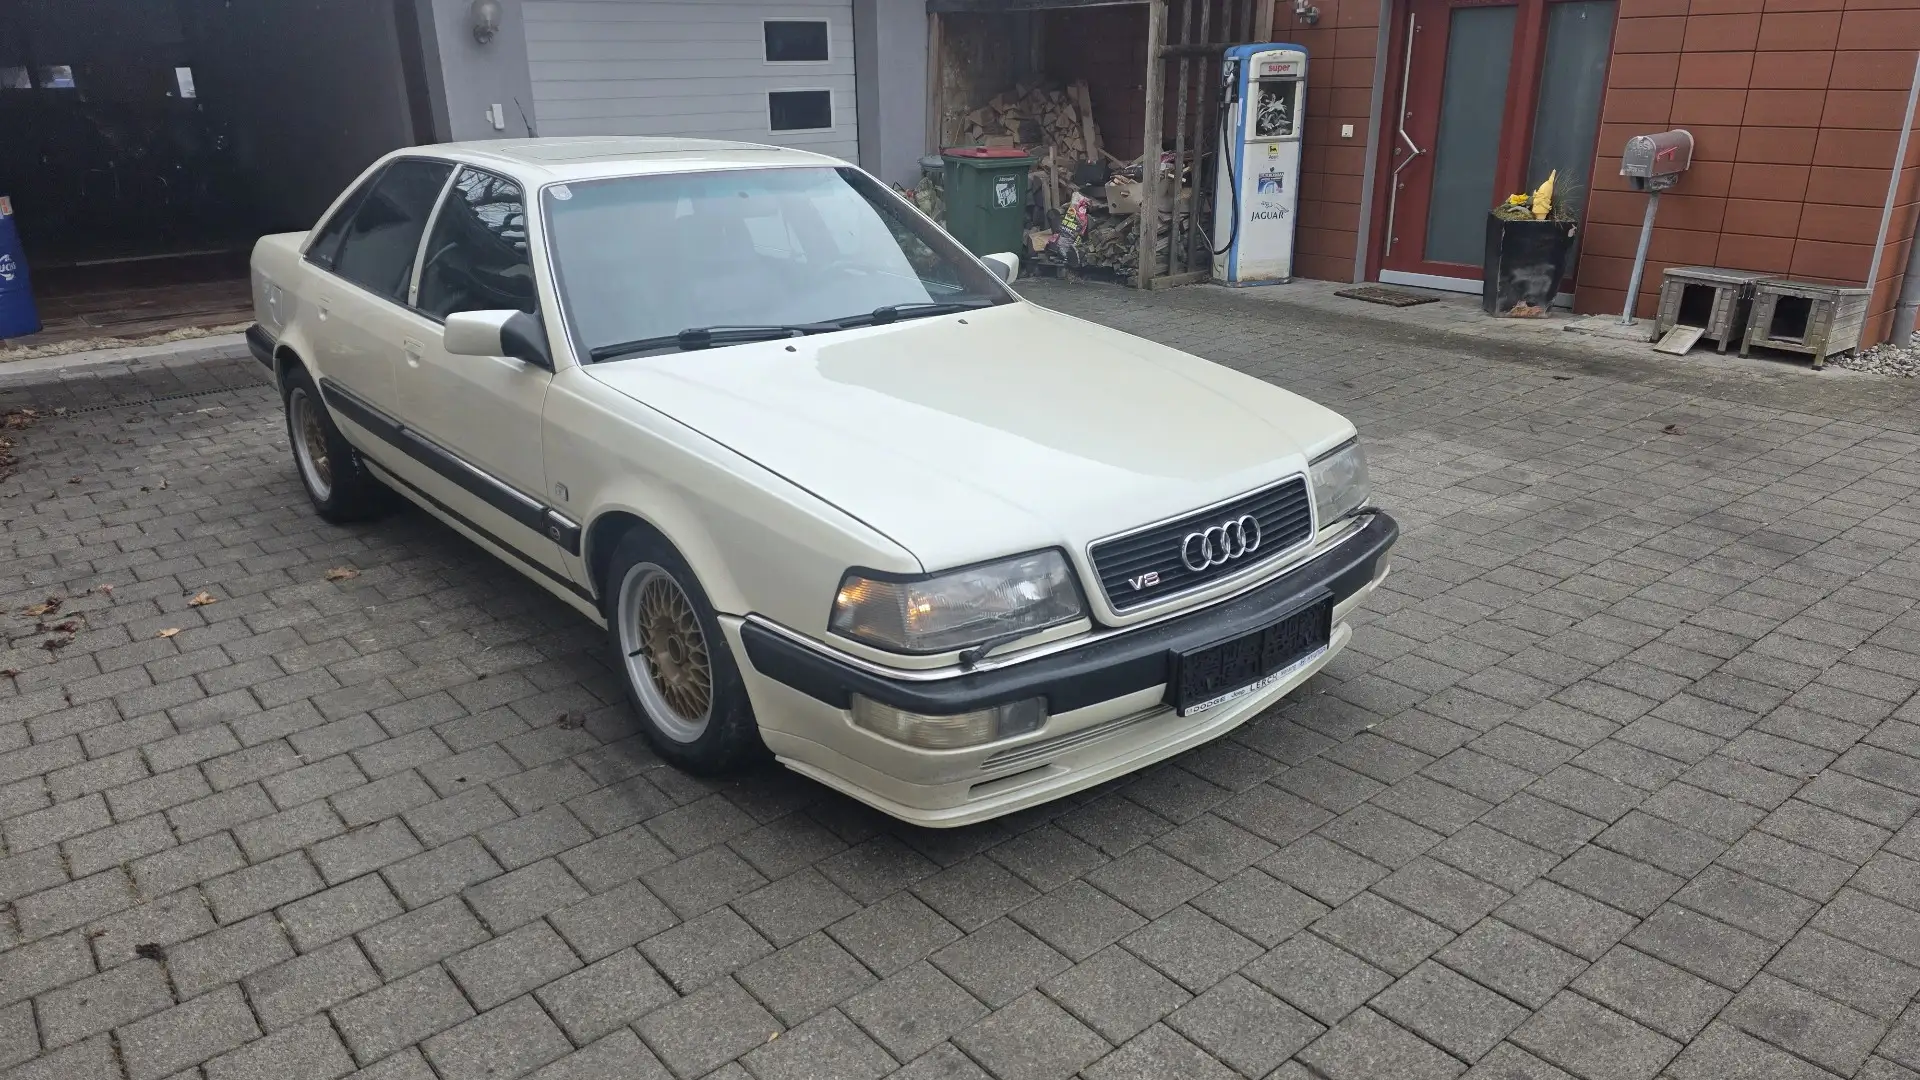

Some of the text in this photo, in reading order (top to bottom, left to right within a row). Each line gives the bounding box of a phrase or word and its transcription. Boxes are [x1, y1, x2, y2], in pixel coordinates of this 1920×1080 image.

[1268, 64, 1291, 73] super
[1251, 211, 1285, 221] JAGUAR
[1128, 571, 1160, 590] V8
